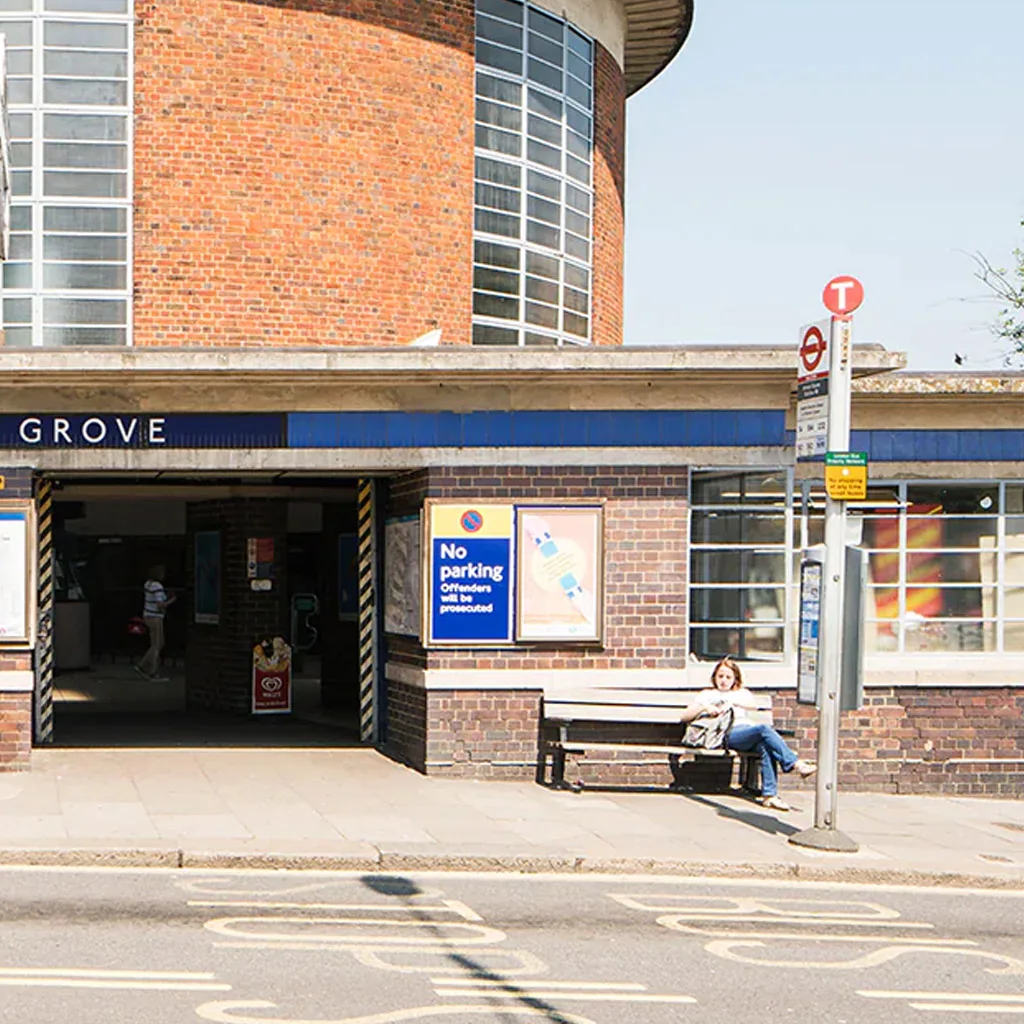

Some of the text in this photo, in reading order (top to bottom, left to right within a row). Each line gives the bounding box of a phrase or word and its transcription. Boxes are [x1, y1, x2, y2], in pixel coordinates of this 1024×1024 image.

[830, 281, 855, 311] T
[19, 417, 166, 443] GROVE
[440, 543, 468, 560] No
[440, 562, 504, 582] parking
[440, 582, 492, 593] Offenders
[440, 593, 473, 603] will be
[439, 603, 494, 615] prosecuted
[174, 877, 549, 975] STOP
[605, 892, 1024, 975] BUS
